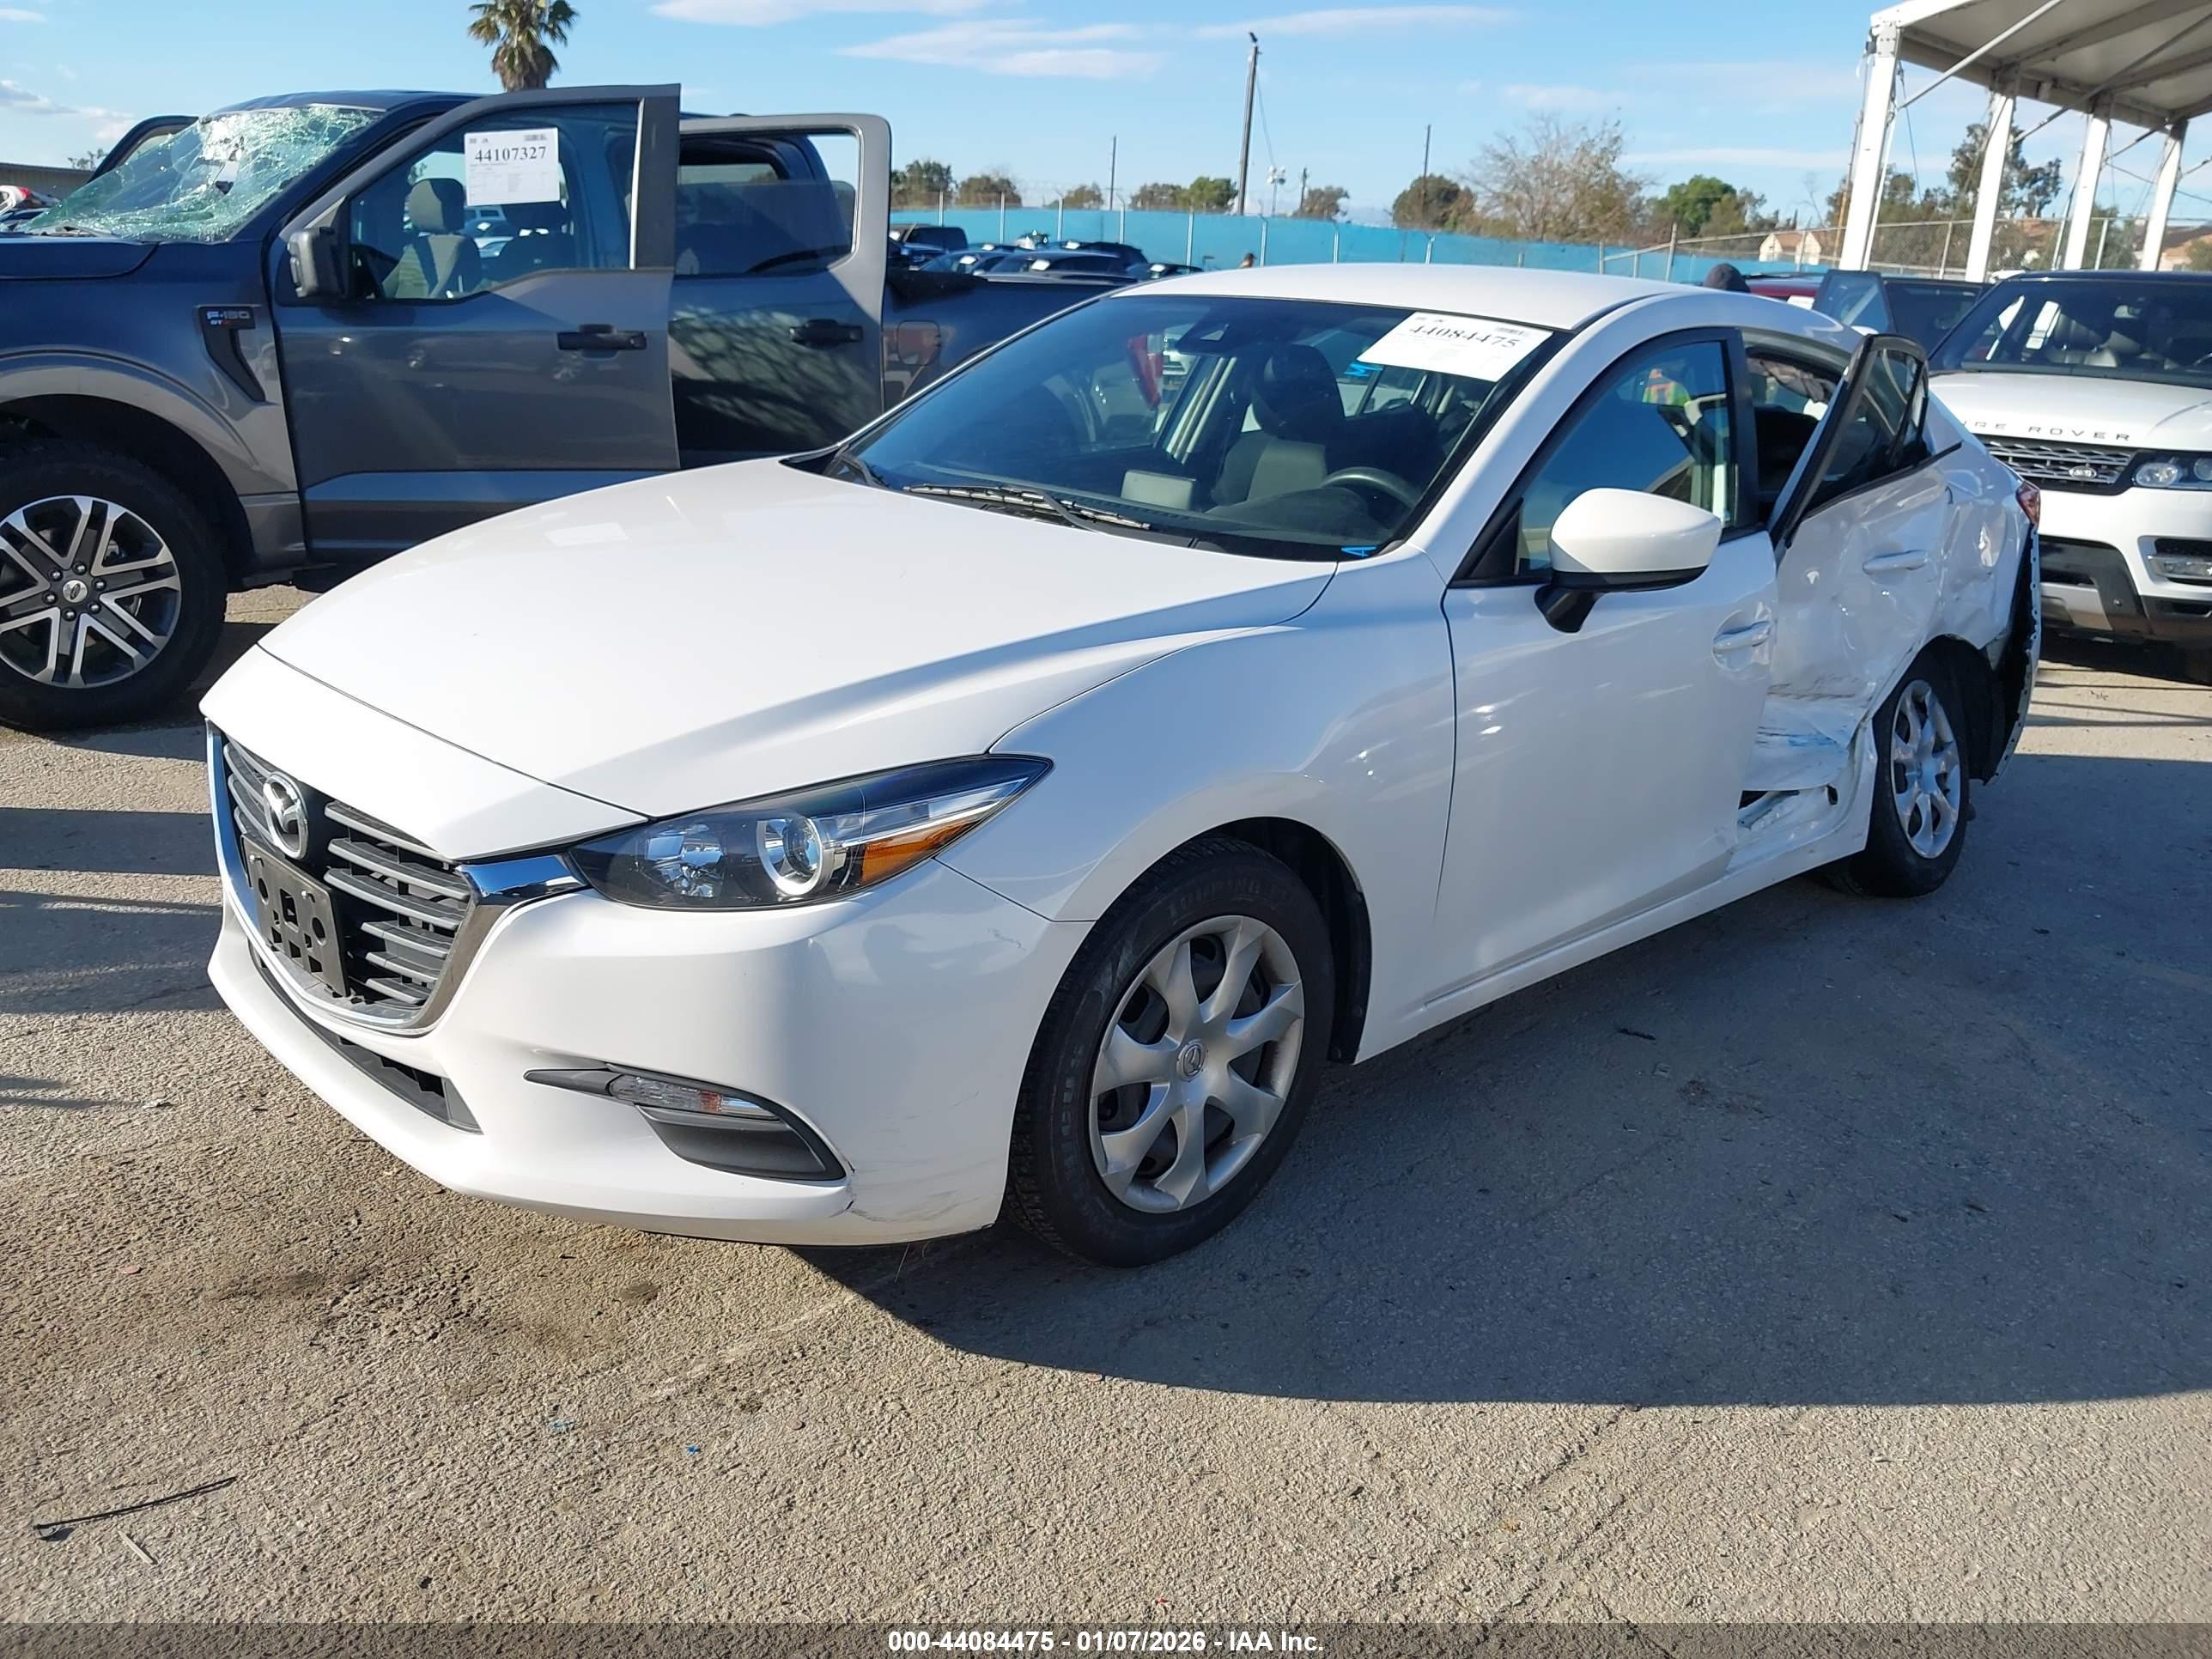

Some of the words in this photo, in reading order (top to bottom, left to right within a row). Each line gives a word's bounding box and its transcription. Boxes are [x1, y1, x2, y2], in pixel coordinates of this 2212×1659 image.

[474, 146, 547, 162] 44107327
[1408, 325, 1521, 349] 44084475
[2027, 425, 2130, 442] ROVER
